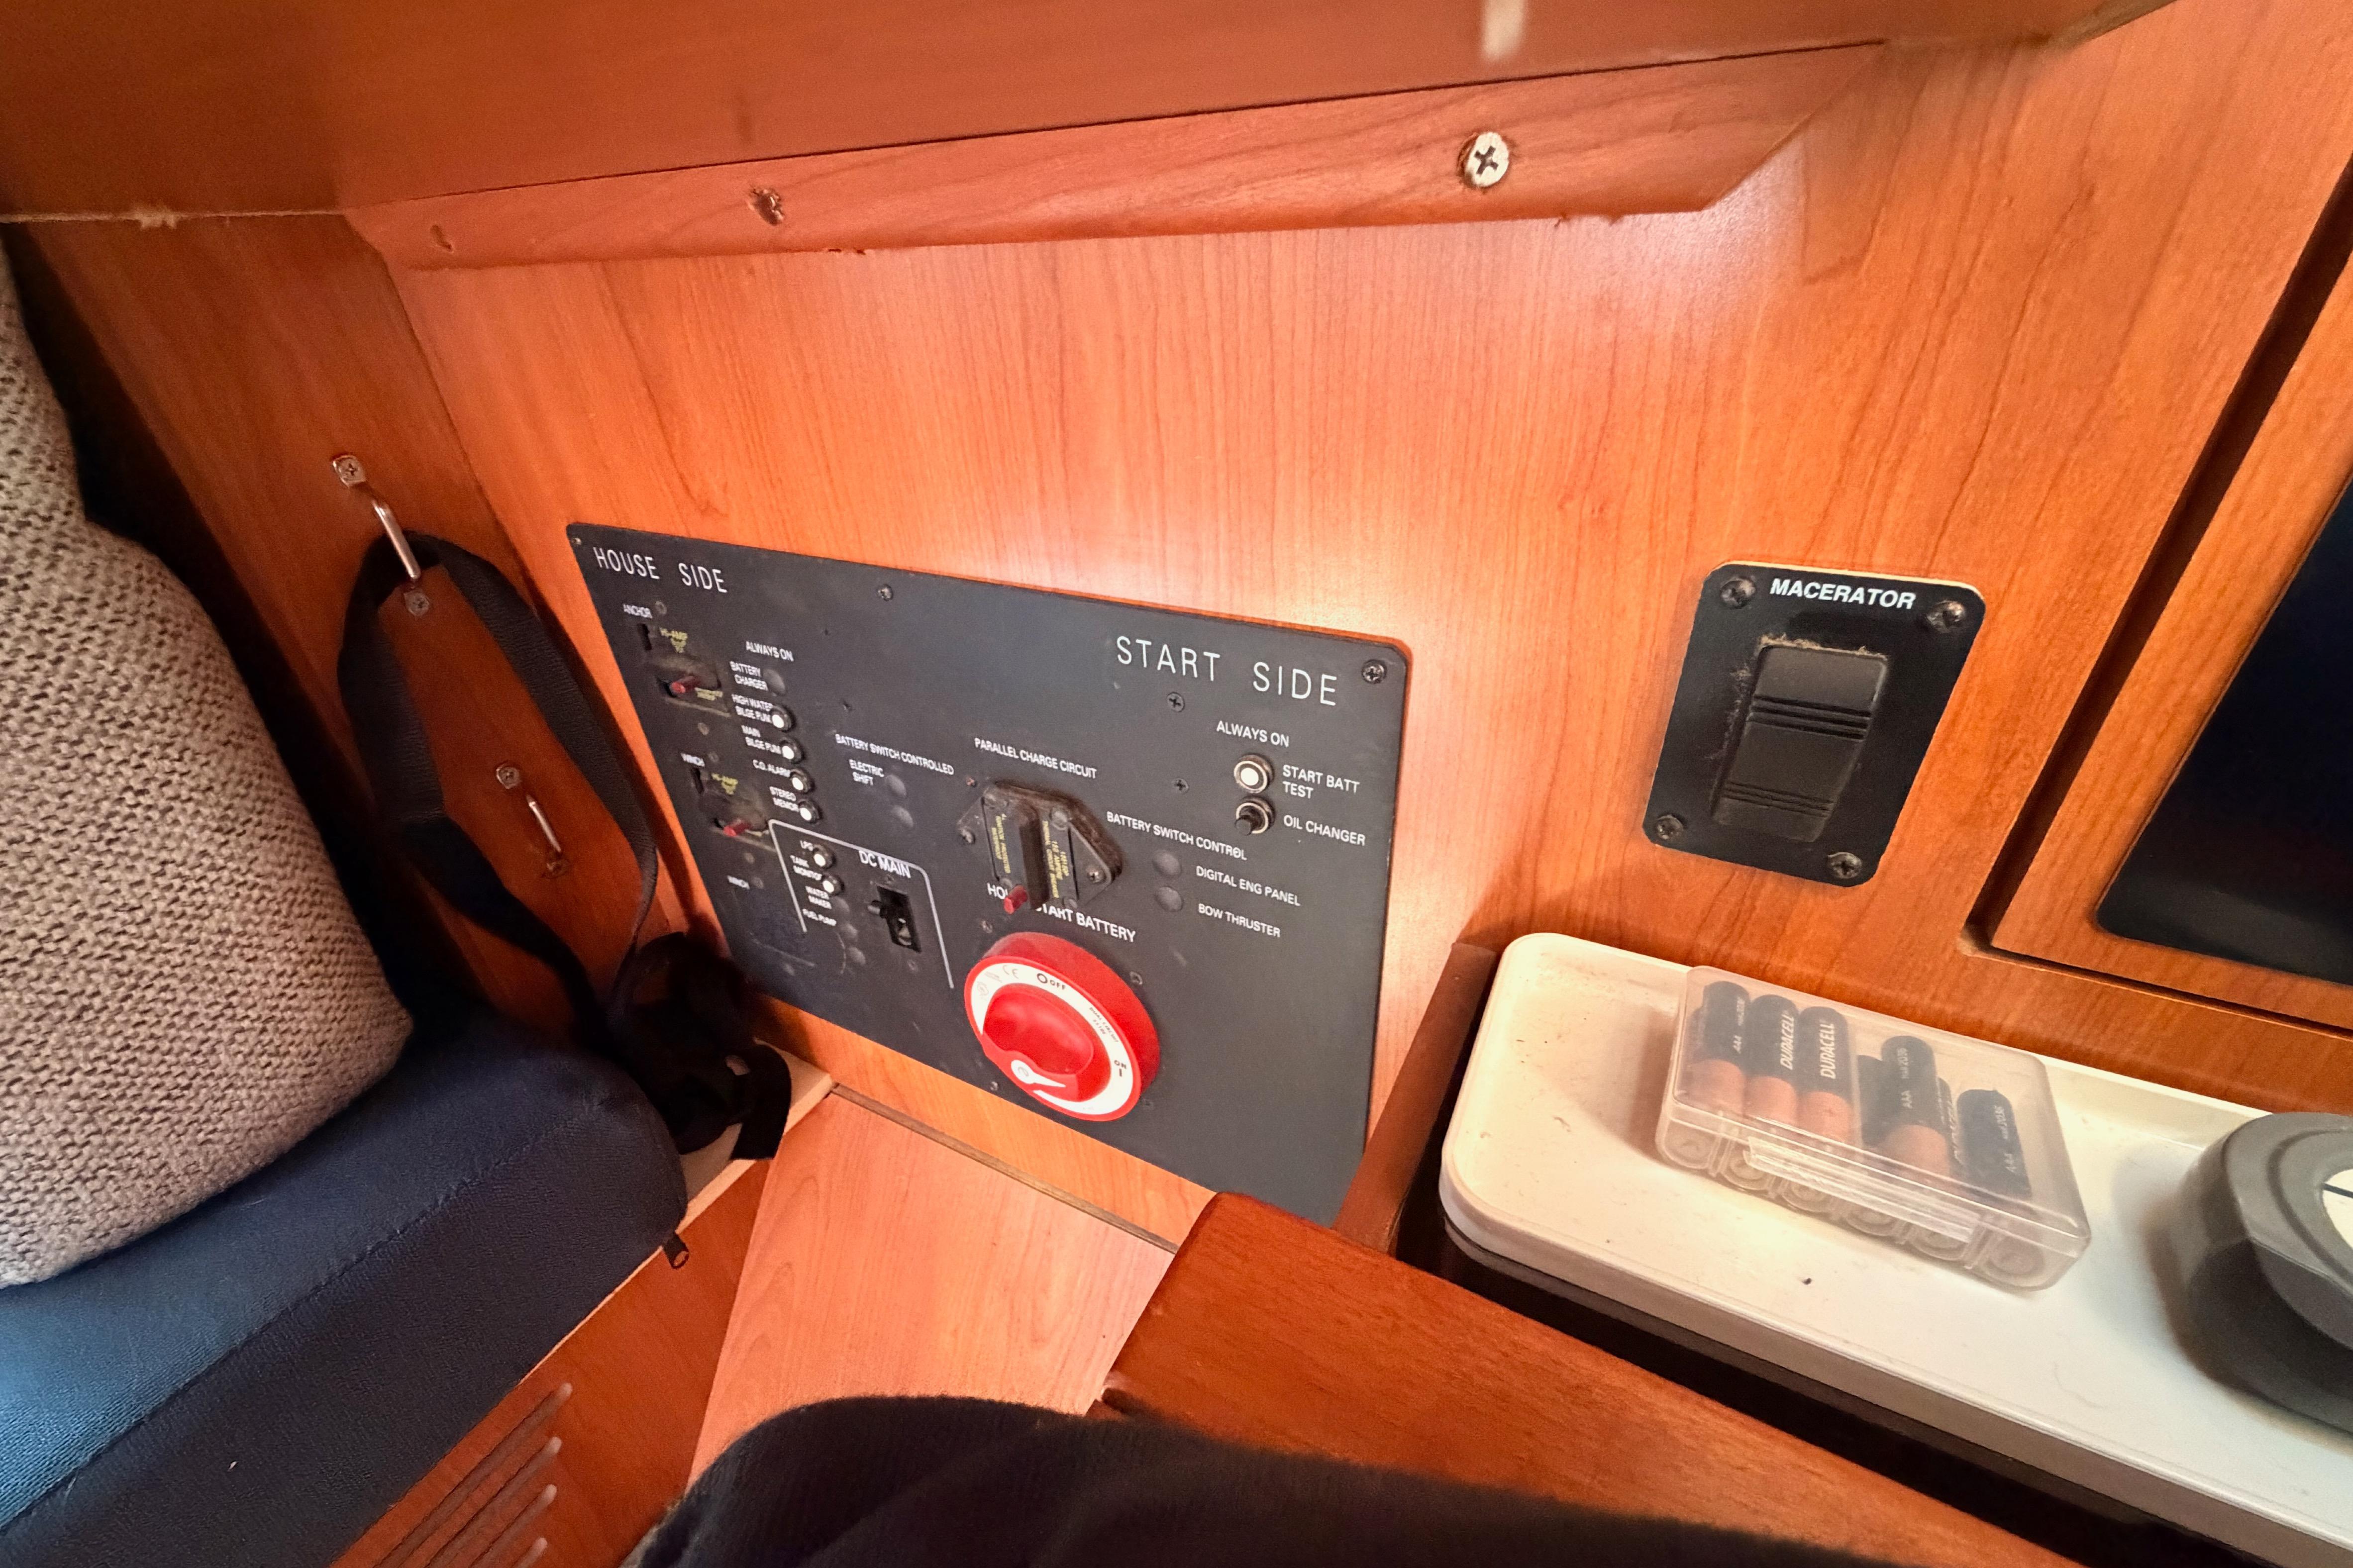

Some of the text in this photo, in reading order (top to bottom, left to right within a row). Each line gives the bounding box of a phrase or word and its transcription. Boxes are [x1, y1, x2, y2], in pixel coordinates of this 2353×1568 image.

[593, 547, 727, 592] HOUSE SIDE
[1770, 579, 1916, 609] MACERATOR
[623, 604, 652, 618] ANCHOR
[746, 641, 794, 662] ALWAYS ON
[730, 661, 762, 677] BATTERY
[1117, 636, 1337, 706] START SIDE
[734, 674, 768, 691] CHARGER
[731, 694, 749, 705] HIGH
[735, 705, 772, 723] BILGE PUM
[741, 725, 760, 738] MAIN
[1217, 720, 1289, 747] ALWAYS ON
[745, 736, 781, 755] BILGE PUM
[835, 734, 954, 775] BATTERY SWITCH CONTROLLED
[849, 759, 885, 778] ELECTRIC
[974, 737, 1097, 779] PARALLEL CHARGE CIRCUIT
[852, 772, 873, 786] SHIFT
[1283, 765, 1360, 794] START BATT
[1283, 781, 1313, 799] TEST
[769, 786, 796, 801] STEREO
[773, 797, 799, 812] MEMOR
[1107, 811, 1247, 861] BATTERY SWITCH CONTROL
[1284, 815, 1366, 846] OIL CHANGER
[858, 850, 911, 879] DC MAIN
[1196, 866, 1301, 906] DIGITAL ENG PANEL
[1035, 903, 1136, 942] TART BATTERY
[1198, 903, 1281, 938] BOW THRUSTER
[1050, 980, 1066, 990] OFF
[1780, 1014, 1794, 1070] DURACELL
[1820, 1023, 1836, 1079] DURACELL
[1114, 1060, 1127, 1070] ON
